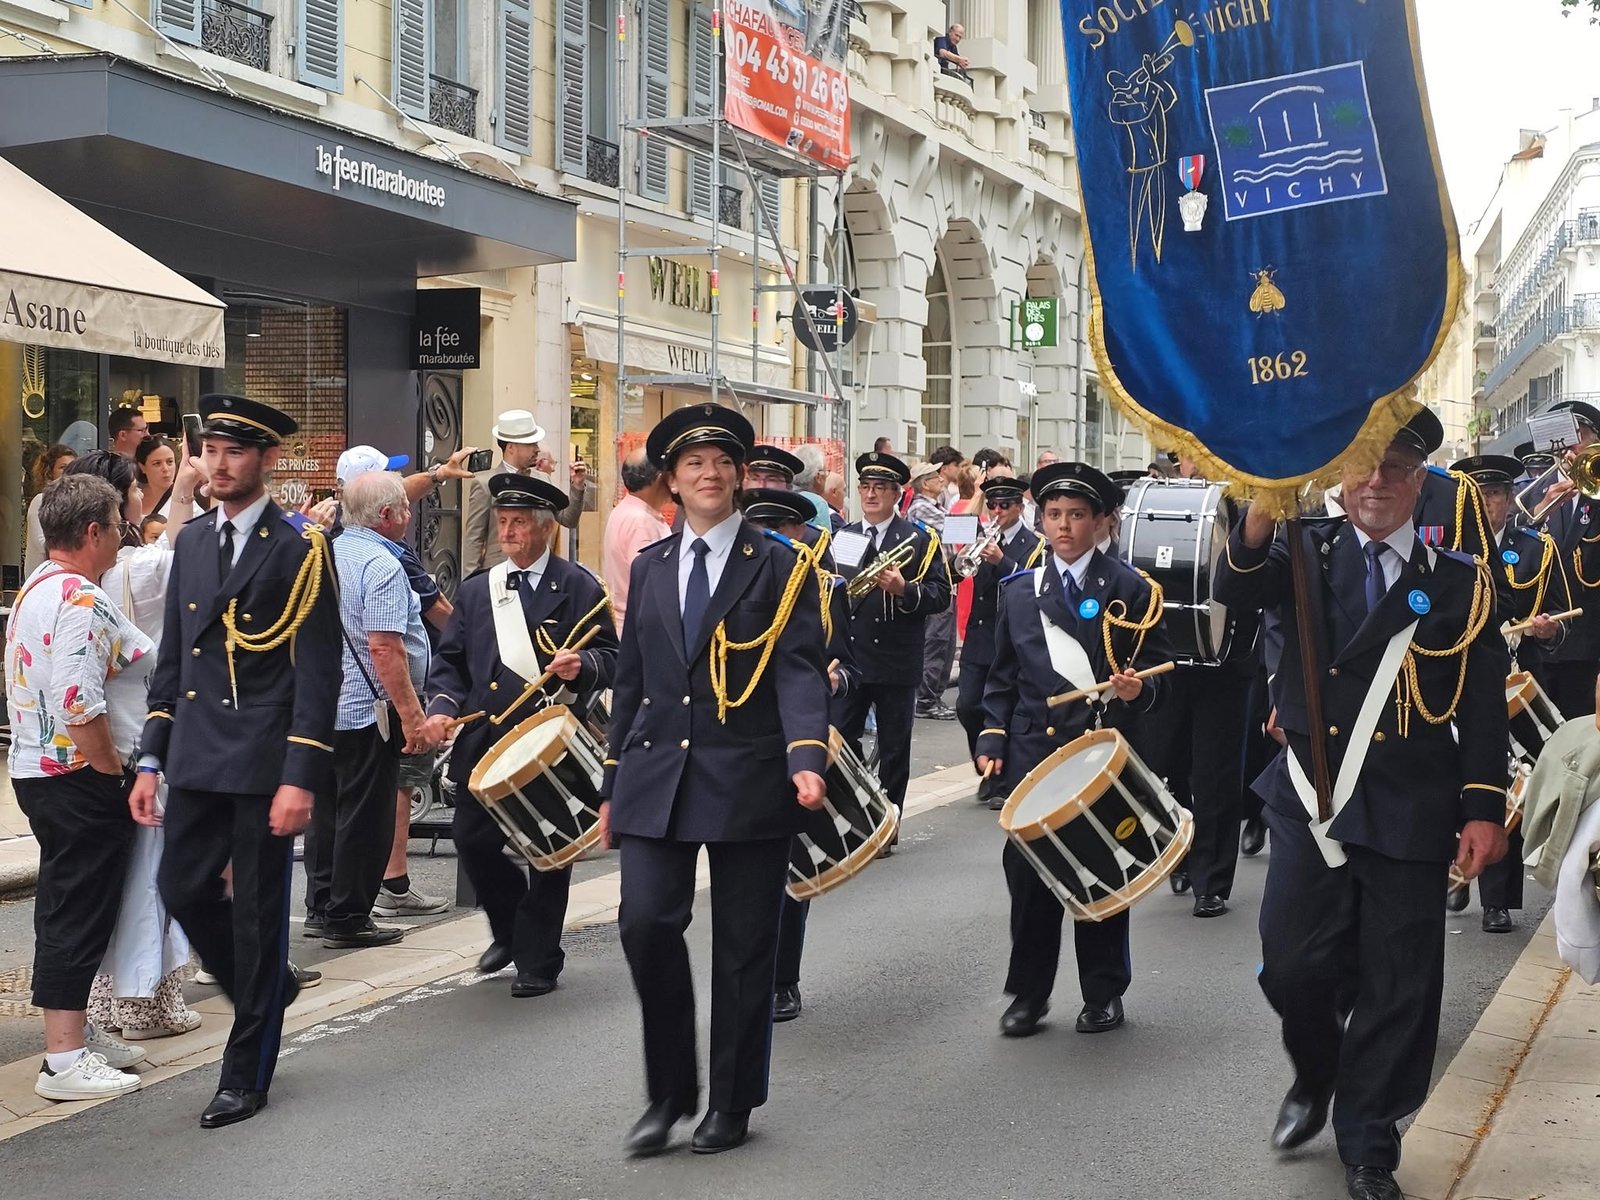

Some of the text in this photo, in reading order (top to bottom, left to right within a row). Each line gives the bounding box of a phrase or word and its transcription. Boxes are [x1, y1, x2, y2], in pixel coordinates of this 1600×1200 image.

[735, 31, 762, 73] 04
[765, 45, 789, 84] 43
[811, 66, 828, 104] 26
[316, 145, 332, 175] la
[1234, 171, 1363, 208] VICHY
[2, 288, 87, 335] Asane
[133, 330, 142, 348] la
[144, 332, 185, 358] boutique
[186, 339, 201, 355] des
[419, 326, 460, 354] la fée
[419, 352, 475, 364] maraboutée
[1248, 350, 1309, 385] 1862
